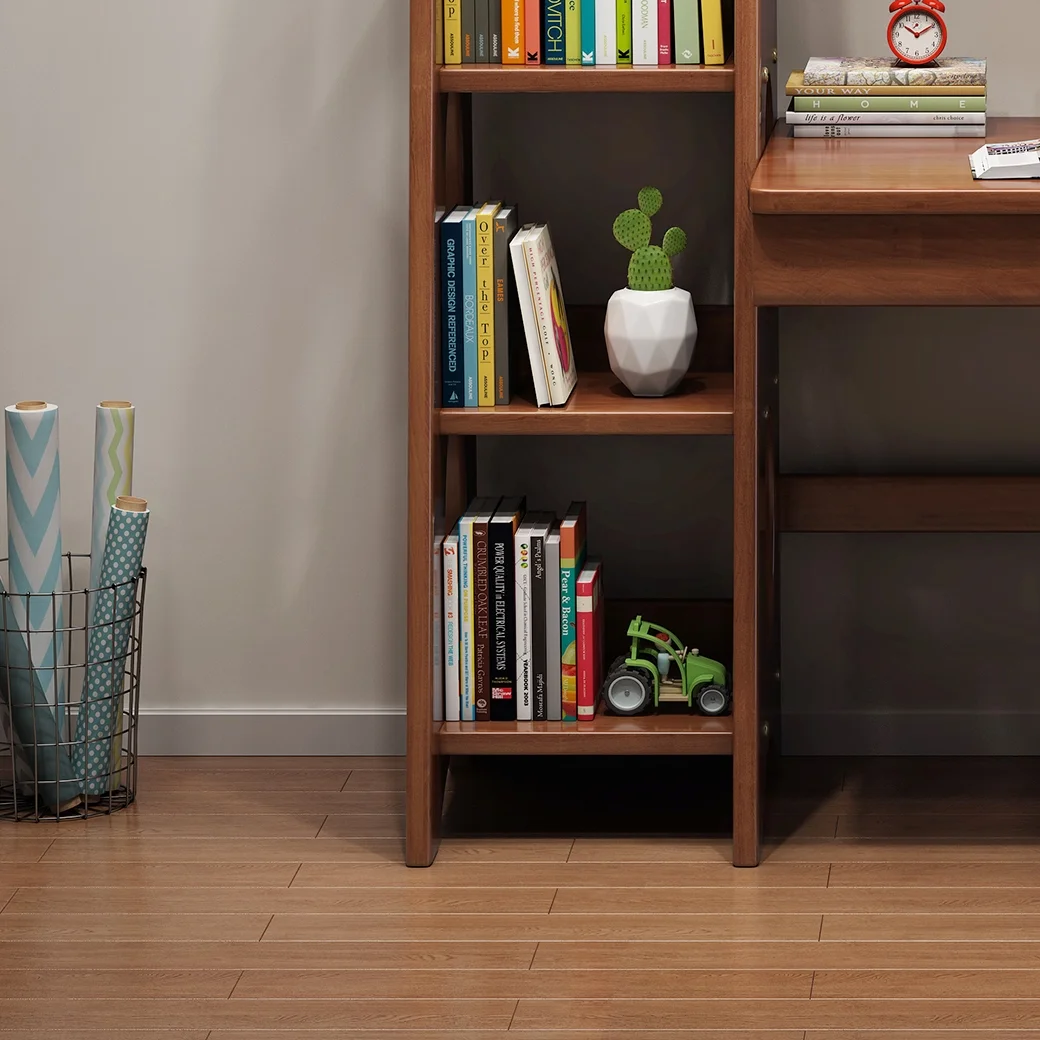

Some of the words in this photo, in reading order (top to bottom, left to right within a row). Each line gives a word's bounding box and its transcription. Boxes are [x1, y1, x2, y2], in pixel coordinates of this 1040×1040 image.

[813, 100, 966, 108] HOME
[805, 114, 818, 123] life
[836, 114, 860, 123] flower
[480, 222, 488, 265] Over
[446, 239, 455, 277] GRAPHIC
[447, 280, 456, 313] DESIGN
[465, 295, 474, 343] BORDEAUX
[448, 315, 456, 372] REFERENCED
[477, 541, 486, 591] CRUMBLED
[494, 543, 504, 564] POWER
[494, 565, 505, 593] QUALITY
[561, 570, 571, 593] Pear
[477, 593, 487, 614] OAK
[562, 596, 571, 604] &
[477, 616, 487, 638] LEAF
[495, 601, 505, 640] ELECTRICAL
[562, 607, 571, 636] Bacon
[476, 644, 484, 668] Patricia
[496, 641, 506, 670] SYSTEMS
